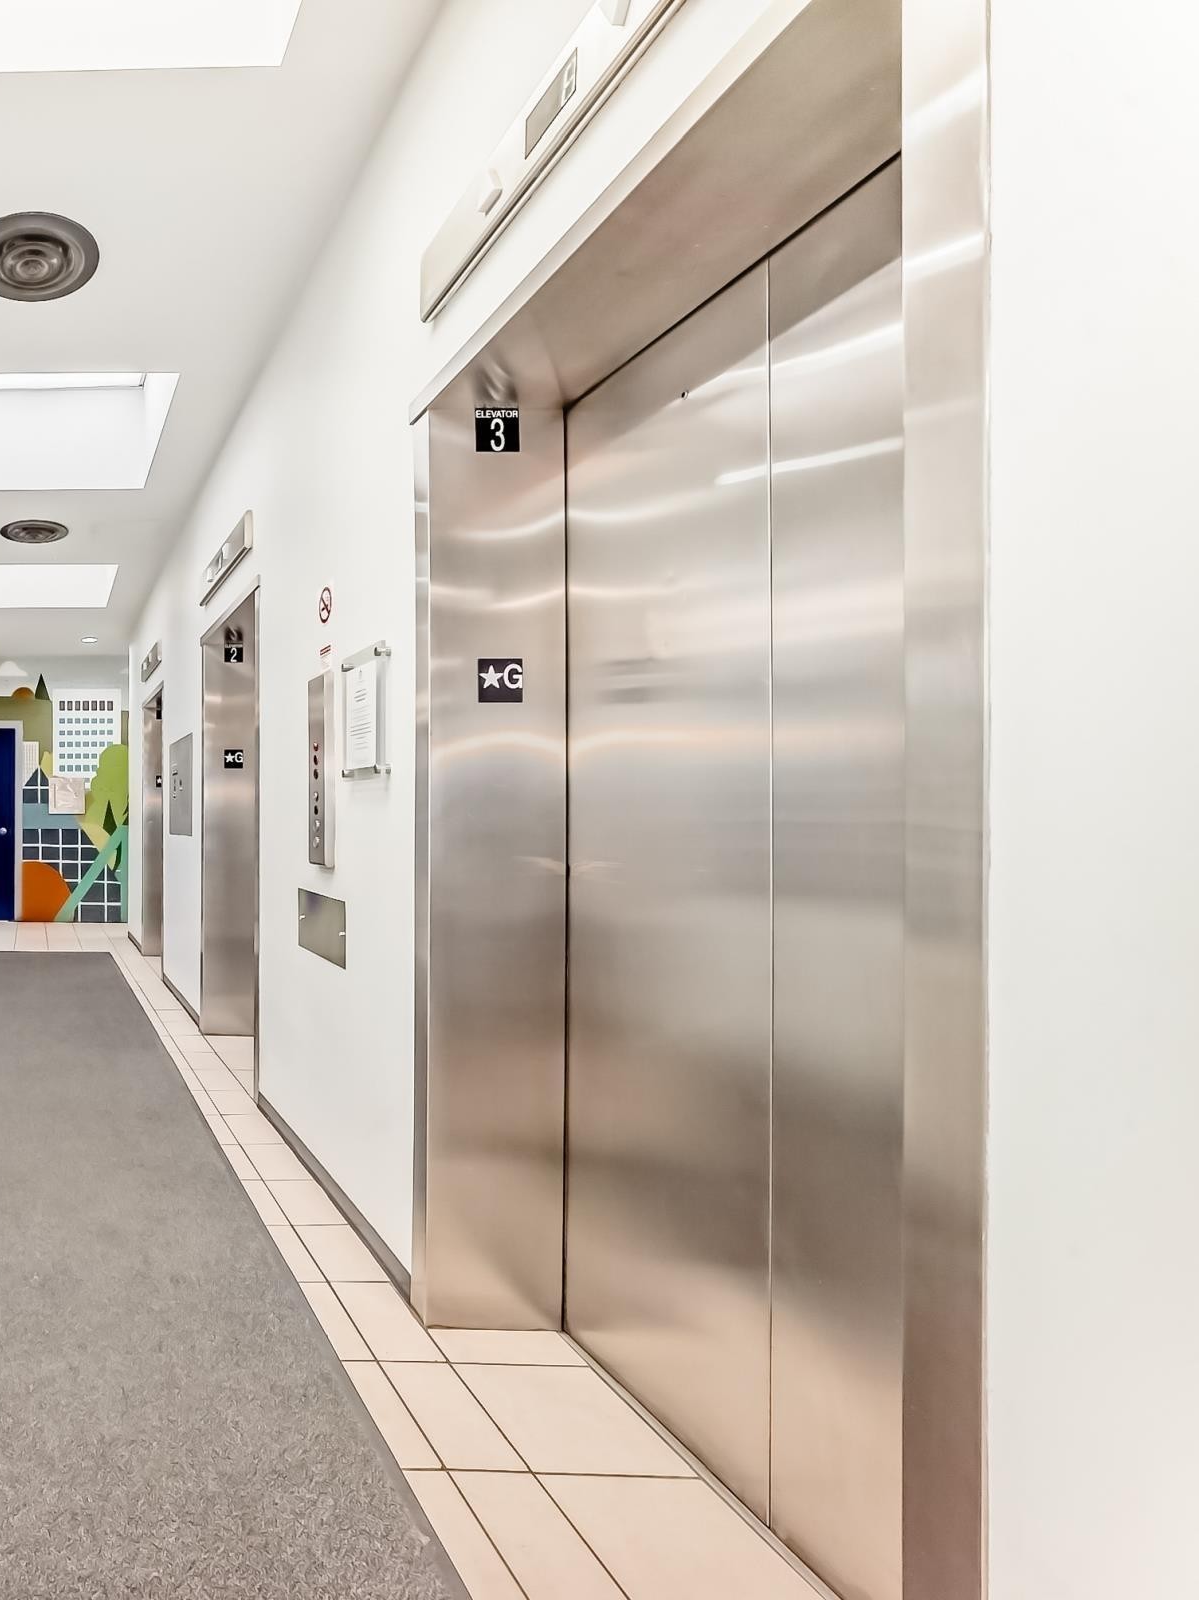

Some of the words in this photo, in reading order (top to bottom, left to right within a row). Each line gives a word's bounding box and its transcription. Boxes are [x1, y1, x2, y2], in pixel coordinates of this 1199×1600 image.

[475, 409, 518, 418] ELEVATOR
[490, 418, 505, 451] 3
[230, 647, 238, 662] 2
